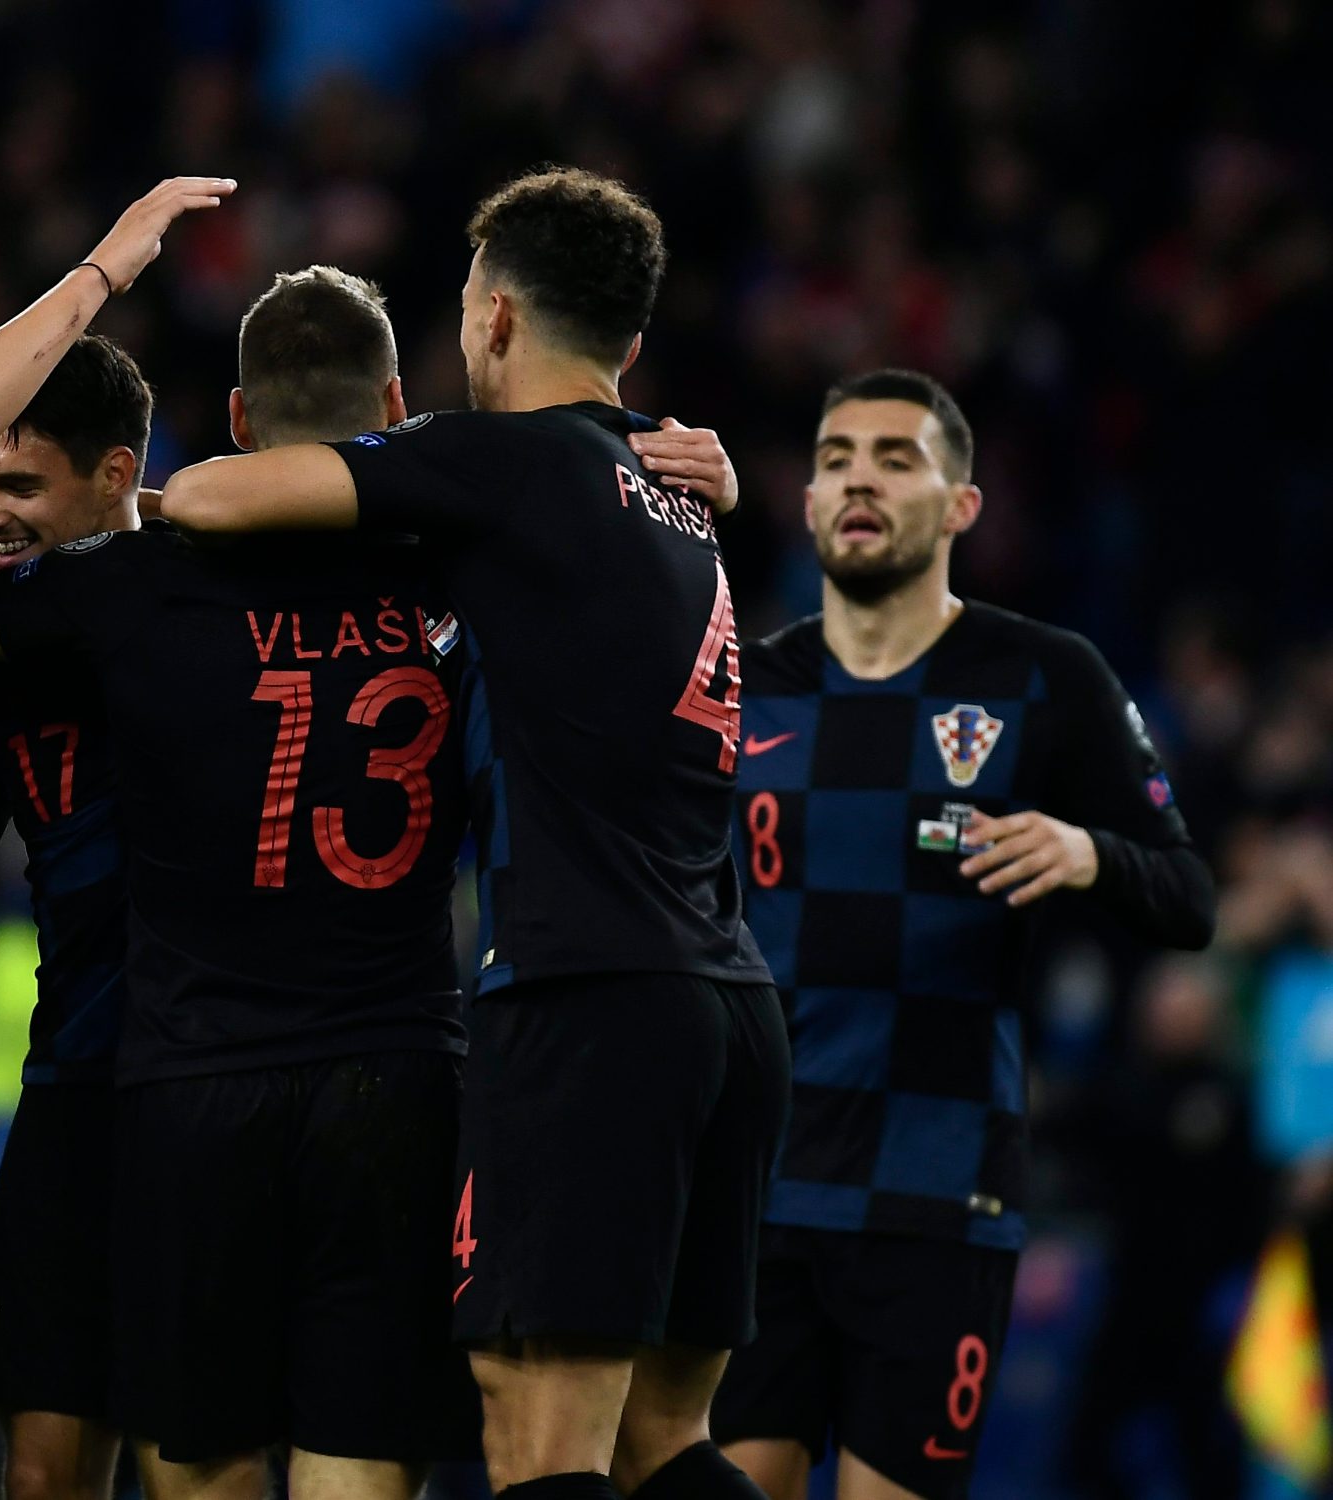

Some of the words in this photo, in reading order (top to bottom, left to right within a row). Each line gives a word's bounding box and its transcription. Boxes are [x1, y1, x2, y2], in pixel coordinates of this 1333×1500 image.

[615, 462, 718, 544] PERIŠI
[246, 596, 430, 664] VLAŠI
[671, 552, 742, 776] 4
[7, 719, 81, 825] 17
[250, 664, 453, 891] 13
[746, 790, 785, 889] 8
[452, 1167, 479, 1269] 4
[946, 1333, 989, 1433] 8
